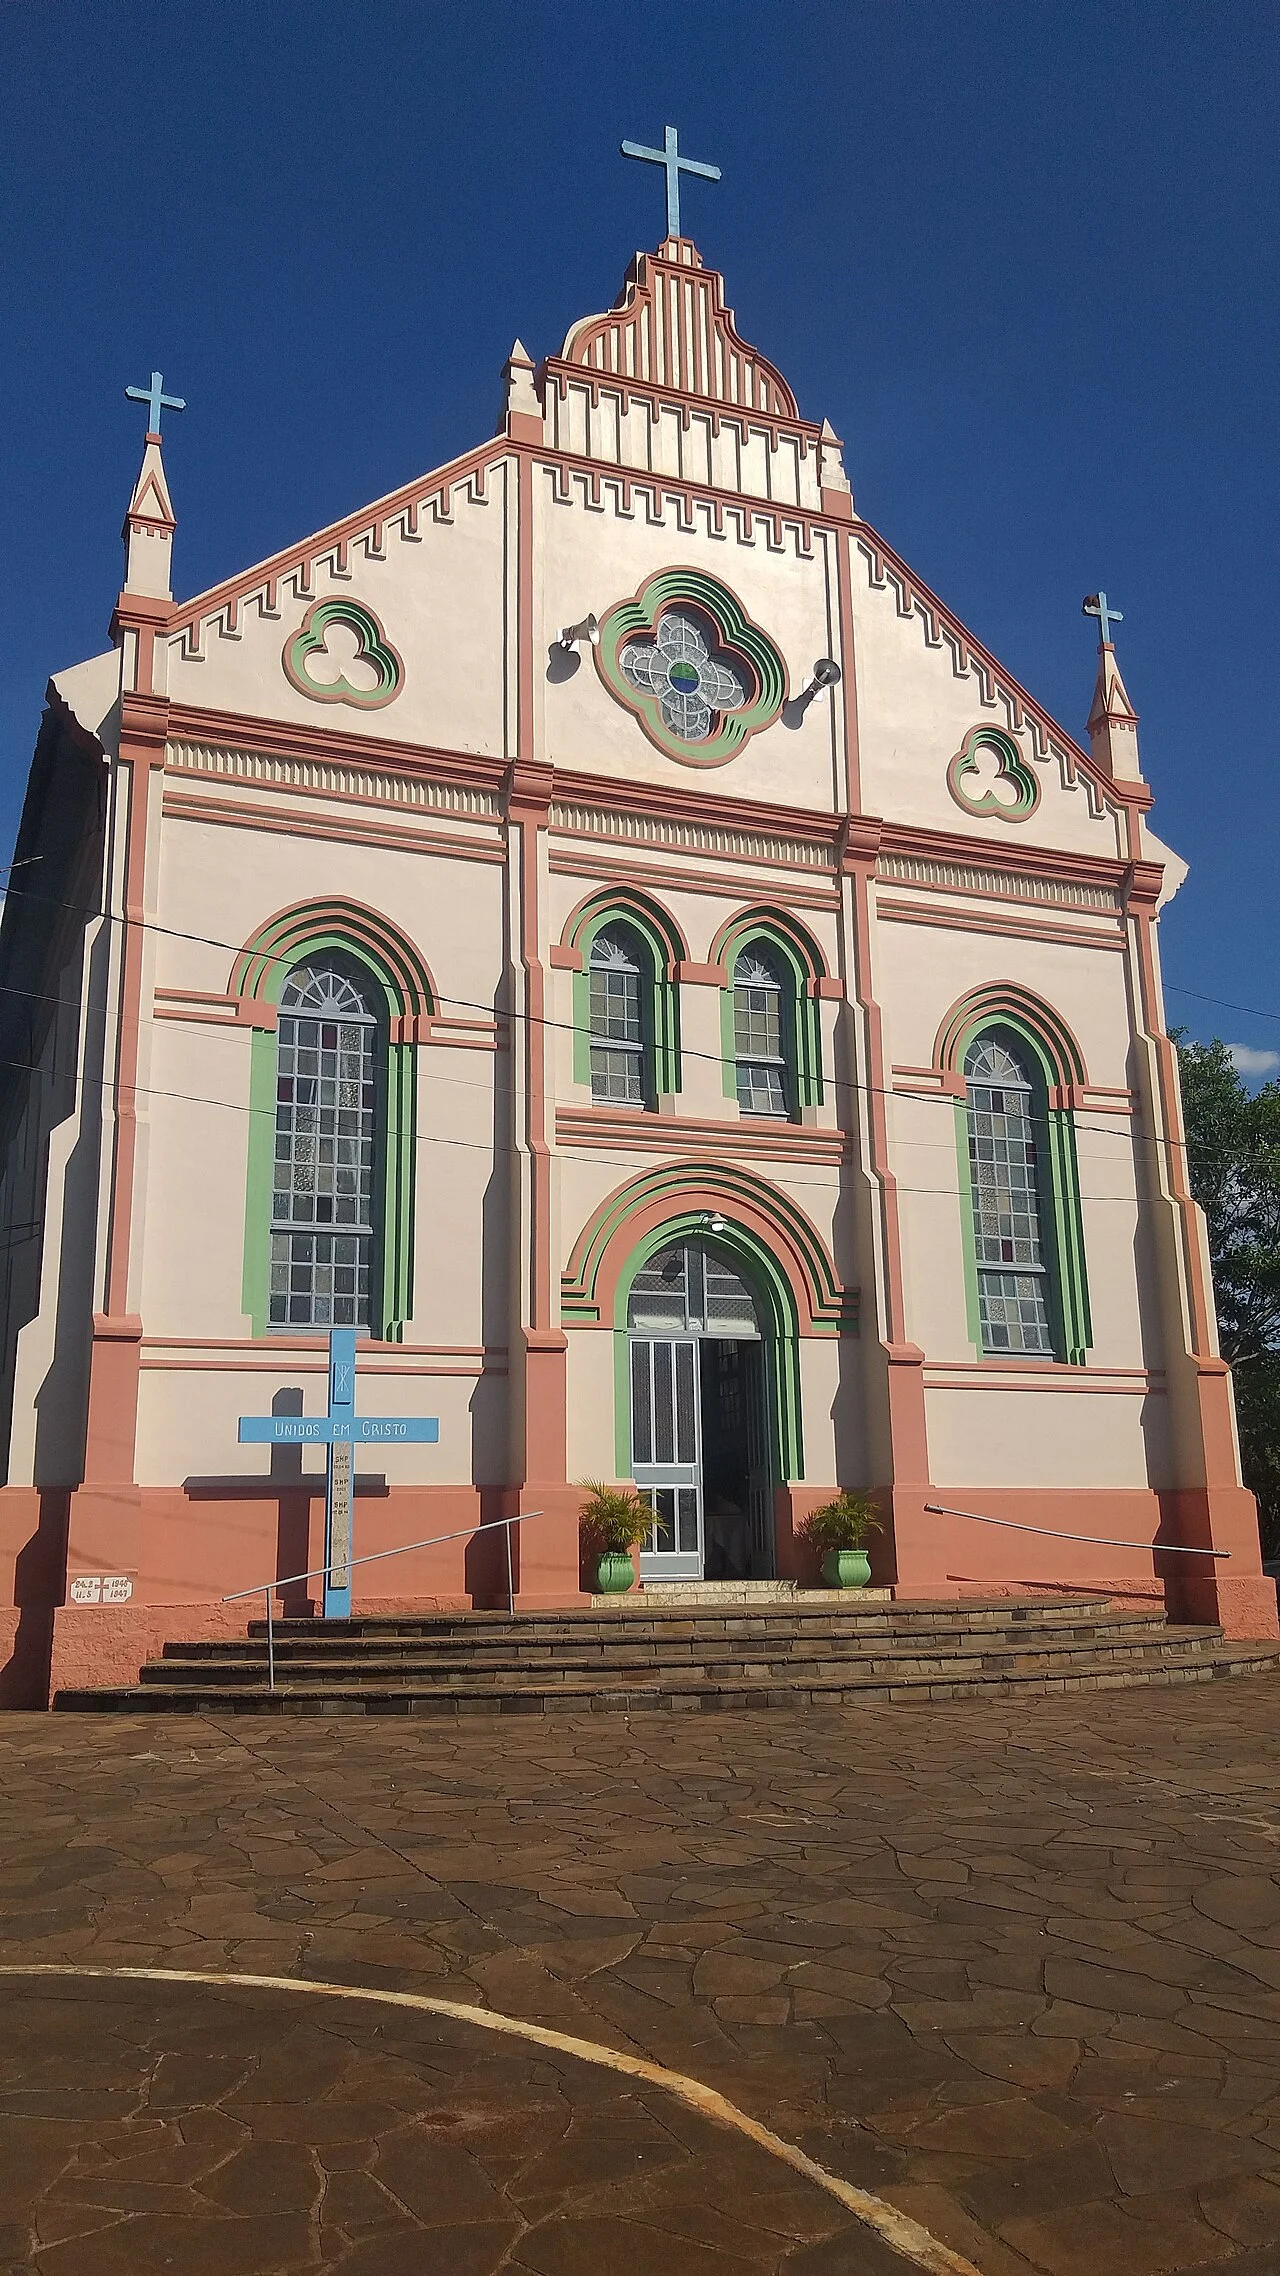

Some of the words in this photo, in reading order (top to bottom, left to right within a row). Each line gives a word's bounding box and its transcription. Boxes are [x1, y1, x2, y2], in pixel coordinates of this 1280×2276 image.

[275, 1421, 320, 1436] UNIDOS
[333, 1423, 350, 1436] EM
[362, 1420, 407, 1436] CRISTO
[110, 1590, 128, 1598] 1947
